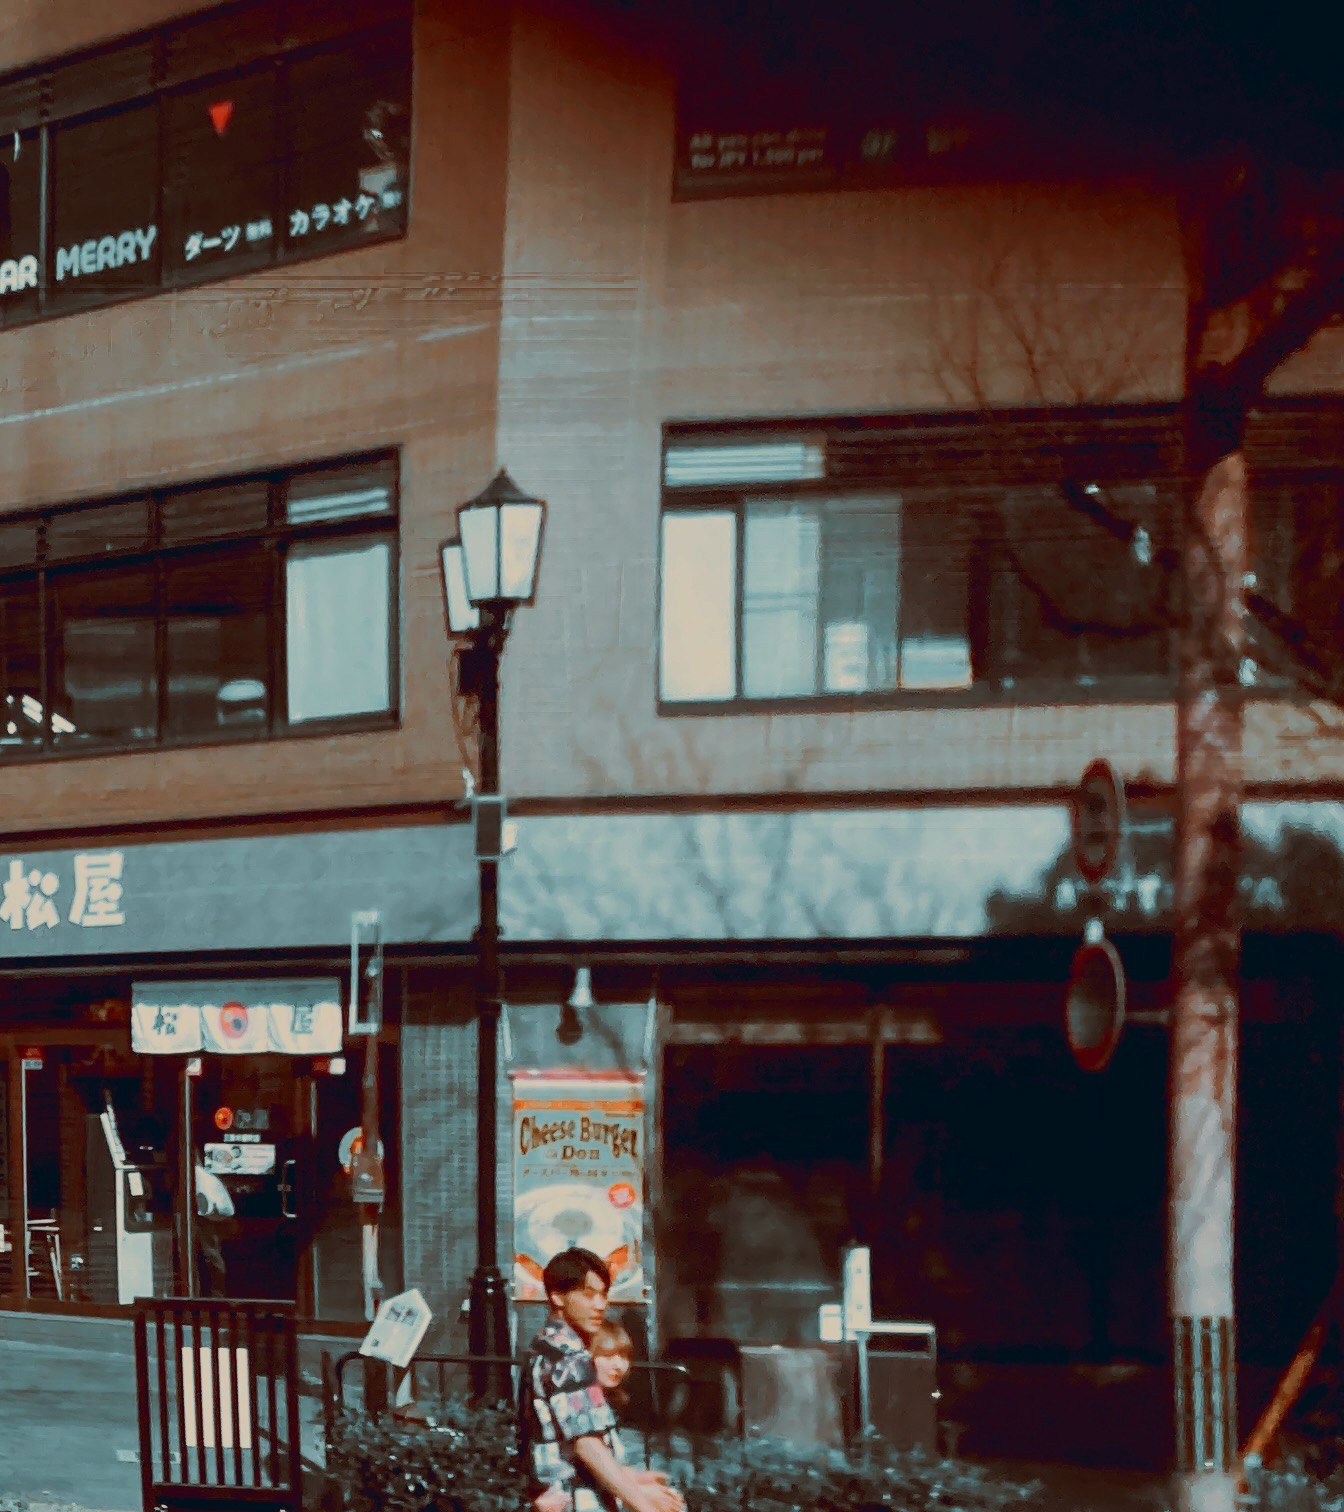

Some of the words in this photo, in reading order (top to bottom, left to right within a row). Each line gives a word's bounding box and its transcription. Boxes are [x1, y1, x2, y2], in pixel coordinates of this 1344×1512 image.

[56, 223, 158, 282] MERRY
[184, 225, 240, 261] ダーツ
[289, 193, 375, 237] カラオケ
[0, 852, 127, 931] 松屋
[153, 1005, 178, 1036] 松
[520, 1115, 576, 1155] Cheese
[579, 1116, 639, 1158] Burger
